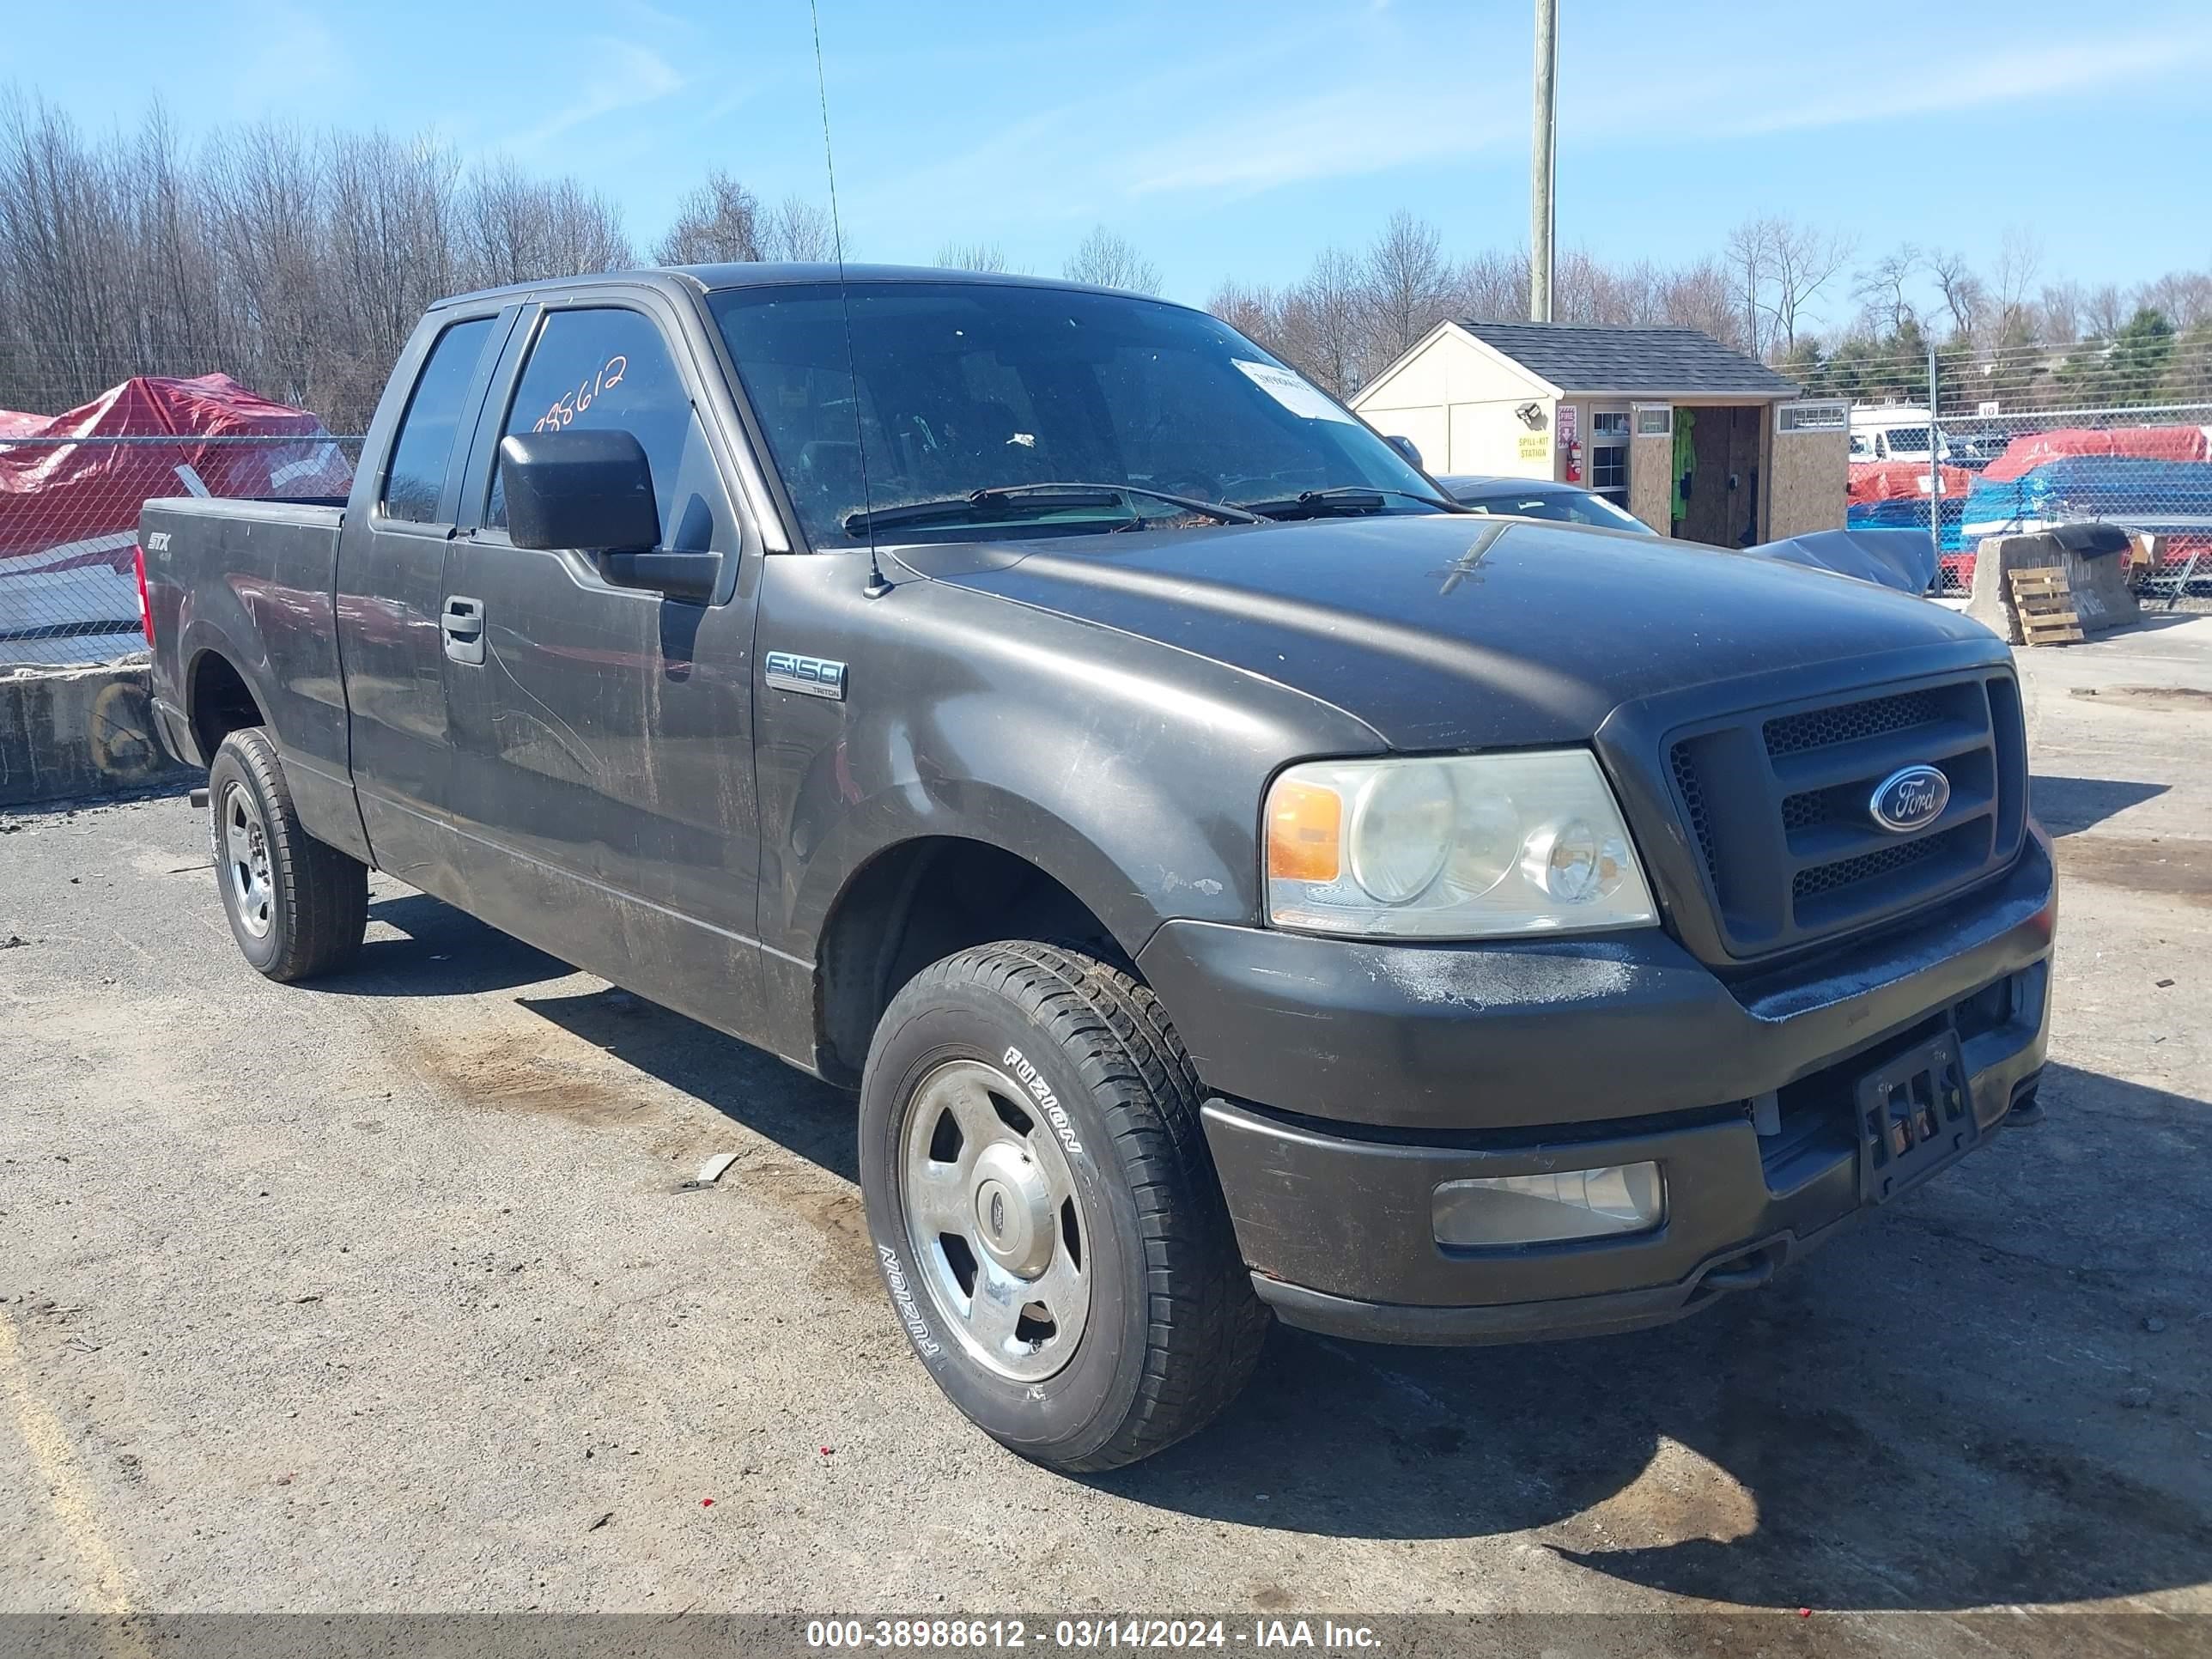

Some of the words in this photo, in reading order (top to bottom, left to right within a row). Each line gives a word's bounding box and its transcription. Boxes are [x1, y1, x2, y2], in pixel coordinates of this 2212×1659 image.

[1560, 411, 1574, 421] FIRE
[1983, 406, 1996, 416] 10
[1519, 436, 1549, 447] SPILL-KIT
[1521, 448, 1547, 459] STATION
[147, 532, 172, 552] STX
[811, 686, 840, 697] TRITON
[1894, 778, 1936, 818] Ford
[1002, 1044, 1084, 1155] FUZION
[878, 1244, 942, 1358] FUZION
